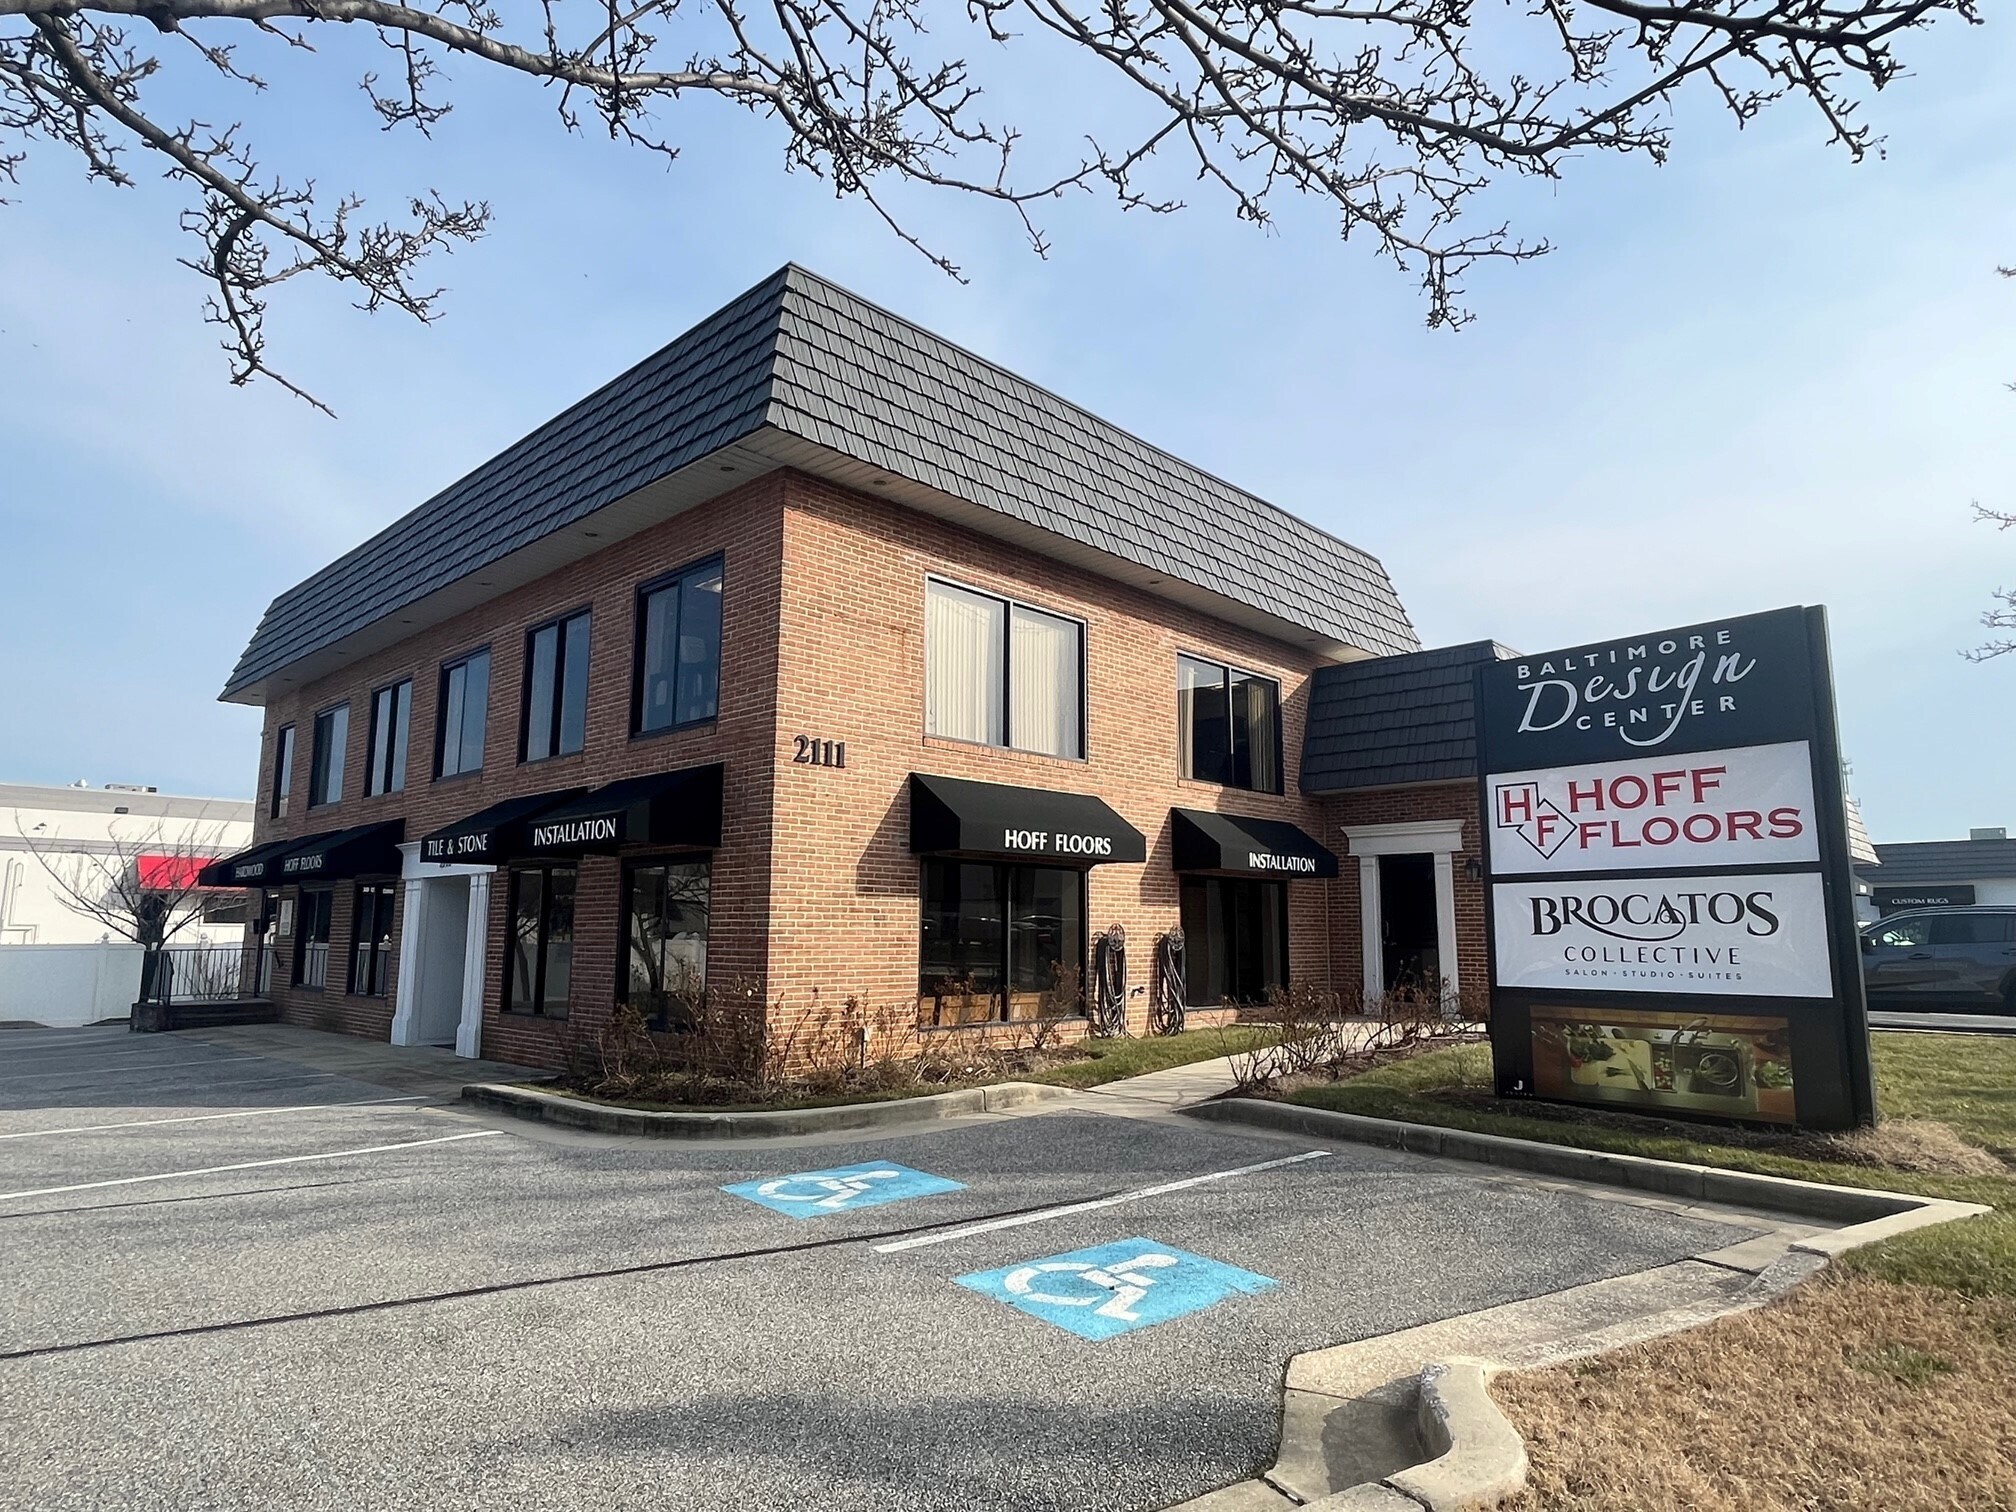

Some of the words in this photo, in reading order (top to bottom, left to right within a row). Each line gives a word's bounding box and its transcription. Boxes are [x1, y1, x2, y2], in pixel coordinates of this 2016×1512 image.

[1517, 630, 1731, 679] BALTIMORE
[1517, 650, 1757, 747] Design
[1575, 695, 1736, 731] CENTER
[794, 734, 846, 768] 2111
[1567, 765, 1727, 814] HOFF
[428, 839, 444, 856] TILE
[447, 839, 454, 855] &
[458, 833, 488, 854] STONE
[533, 817, 616, 847] INSTALLATION
[1004, 828, 1048, 851] HOFF
[1055, 832, 1112, 856] FLOORS
[1578, 808, 1804, 850] FLOORS
[1248, 851, 1316, 873] INSTALLATION
[1529, 892, 1780, 942] BROCATOS
[1564, 946, 1741, 965] COLLECTIVE
[1565, 969, 1608, 977] SALON
[1622, 970, 1675, 979] STUDIO
[1688, 971, 1742, 980] SUITES
